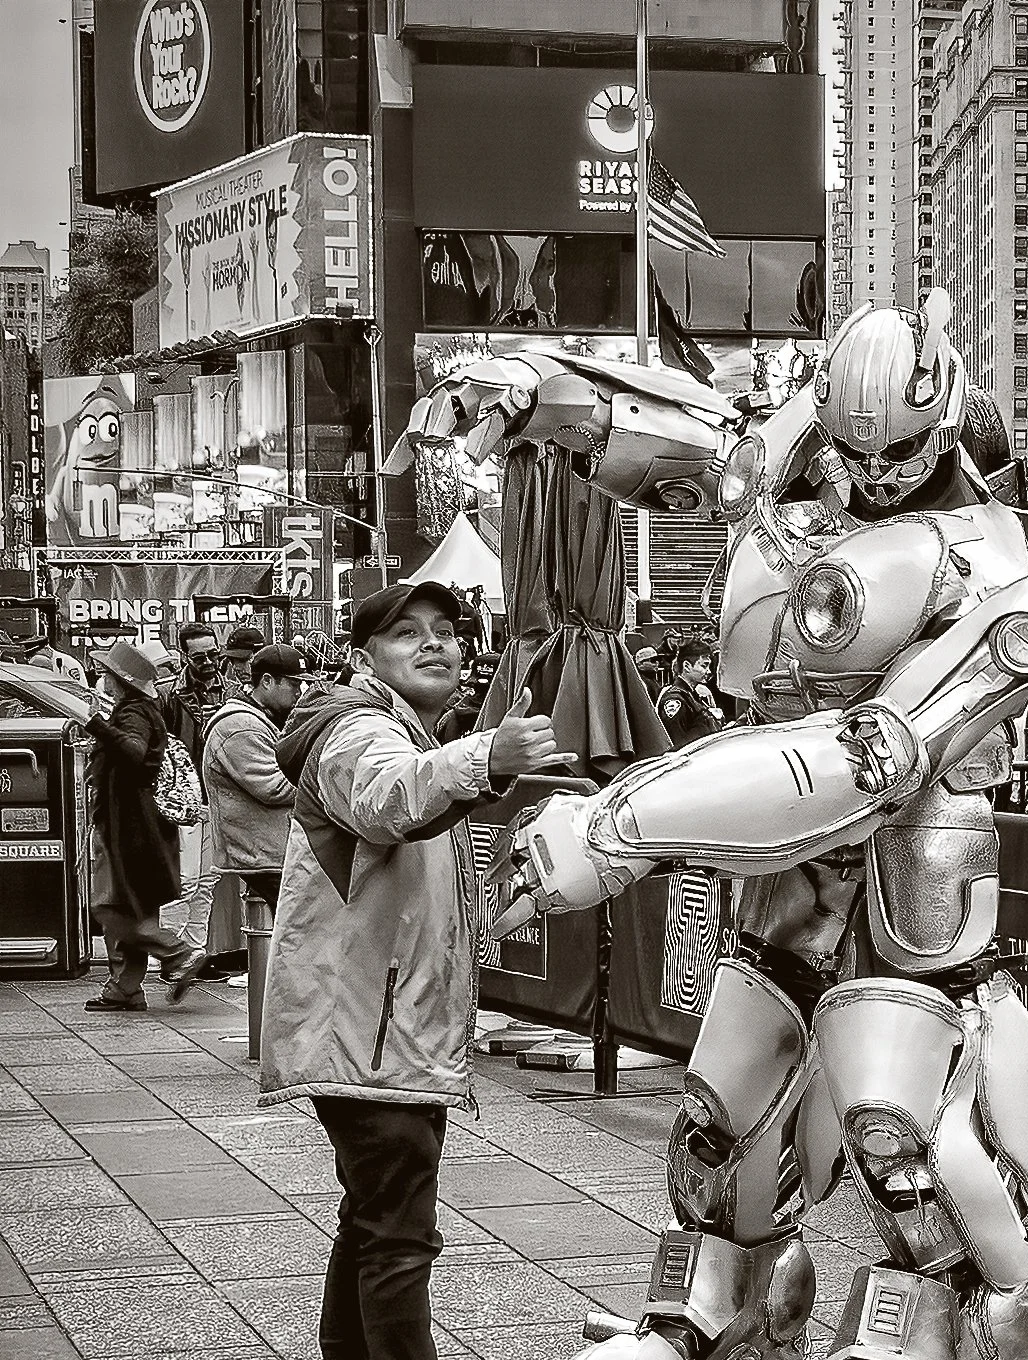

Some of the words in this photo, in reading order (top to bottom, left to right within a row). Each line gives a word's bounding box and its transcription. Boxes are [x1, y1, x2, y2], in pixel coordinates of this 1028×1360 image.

[150, 2, 195, 44] Who's
[149, 42, 184, 76] Your
[152, 66, 197, 110] Rock?
[195, 186, 228, 210] MUSICAL
[229, 169, 264, 198] THEATER
[174, 198, 247, 254] MISSIONARY
[248, 183, 289, 228] STYLE
[322, 146, 360, 309] HELLO!
[281, 512, 324, 599] tkts
[69, 599, 163, 623] BRING
